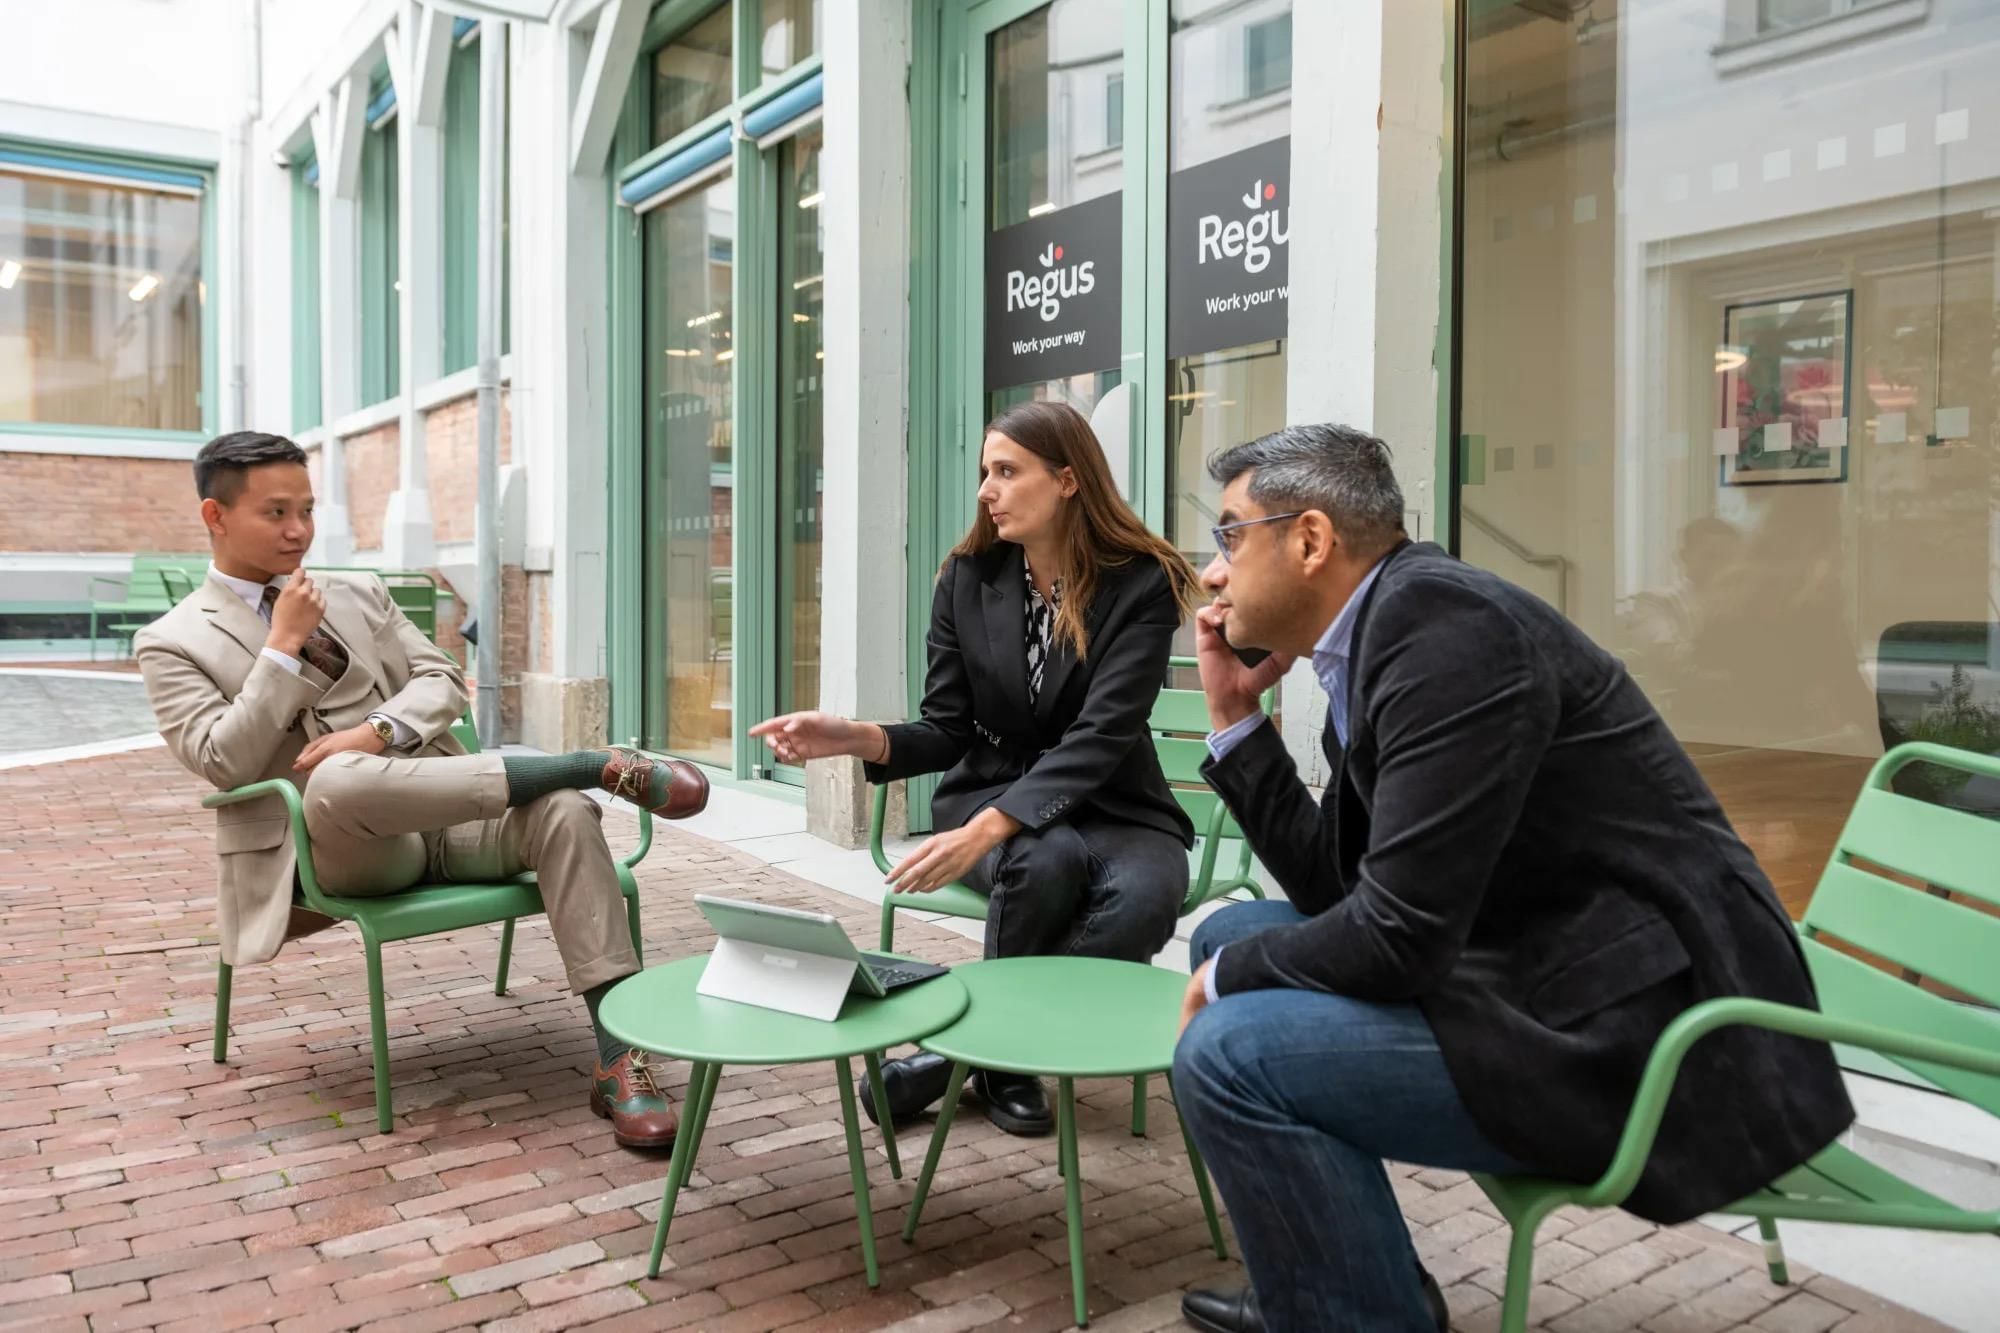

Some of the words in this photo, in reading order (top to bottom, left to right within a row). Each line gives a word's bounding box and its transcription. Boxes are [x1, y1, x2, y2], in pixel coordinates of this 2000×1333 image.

[1199, 209, 1288, 273] Regu
[1007, 260, 1095, 322] Regus
[1205, 292, 1241, 315] Work
[1243, 288, 1275, 312] your
[1012, 337, 1039, 356] Work
[1039, 334, 1063, 354] your
[1064, 329, 1086, 346] way
